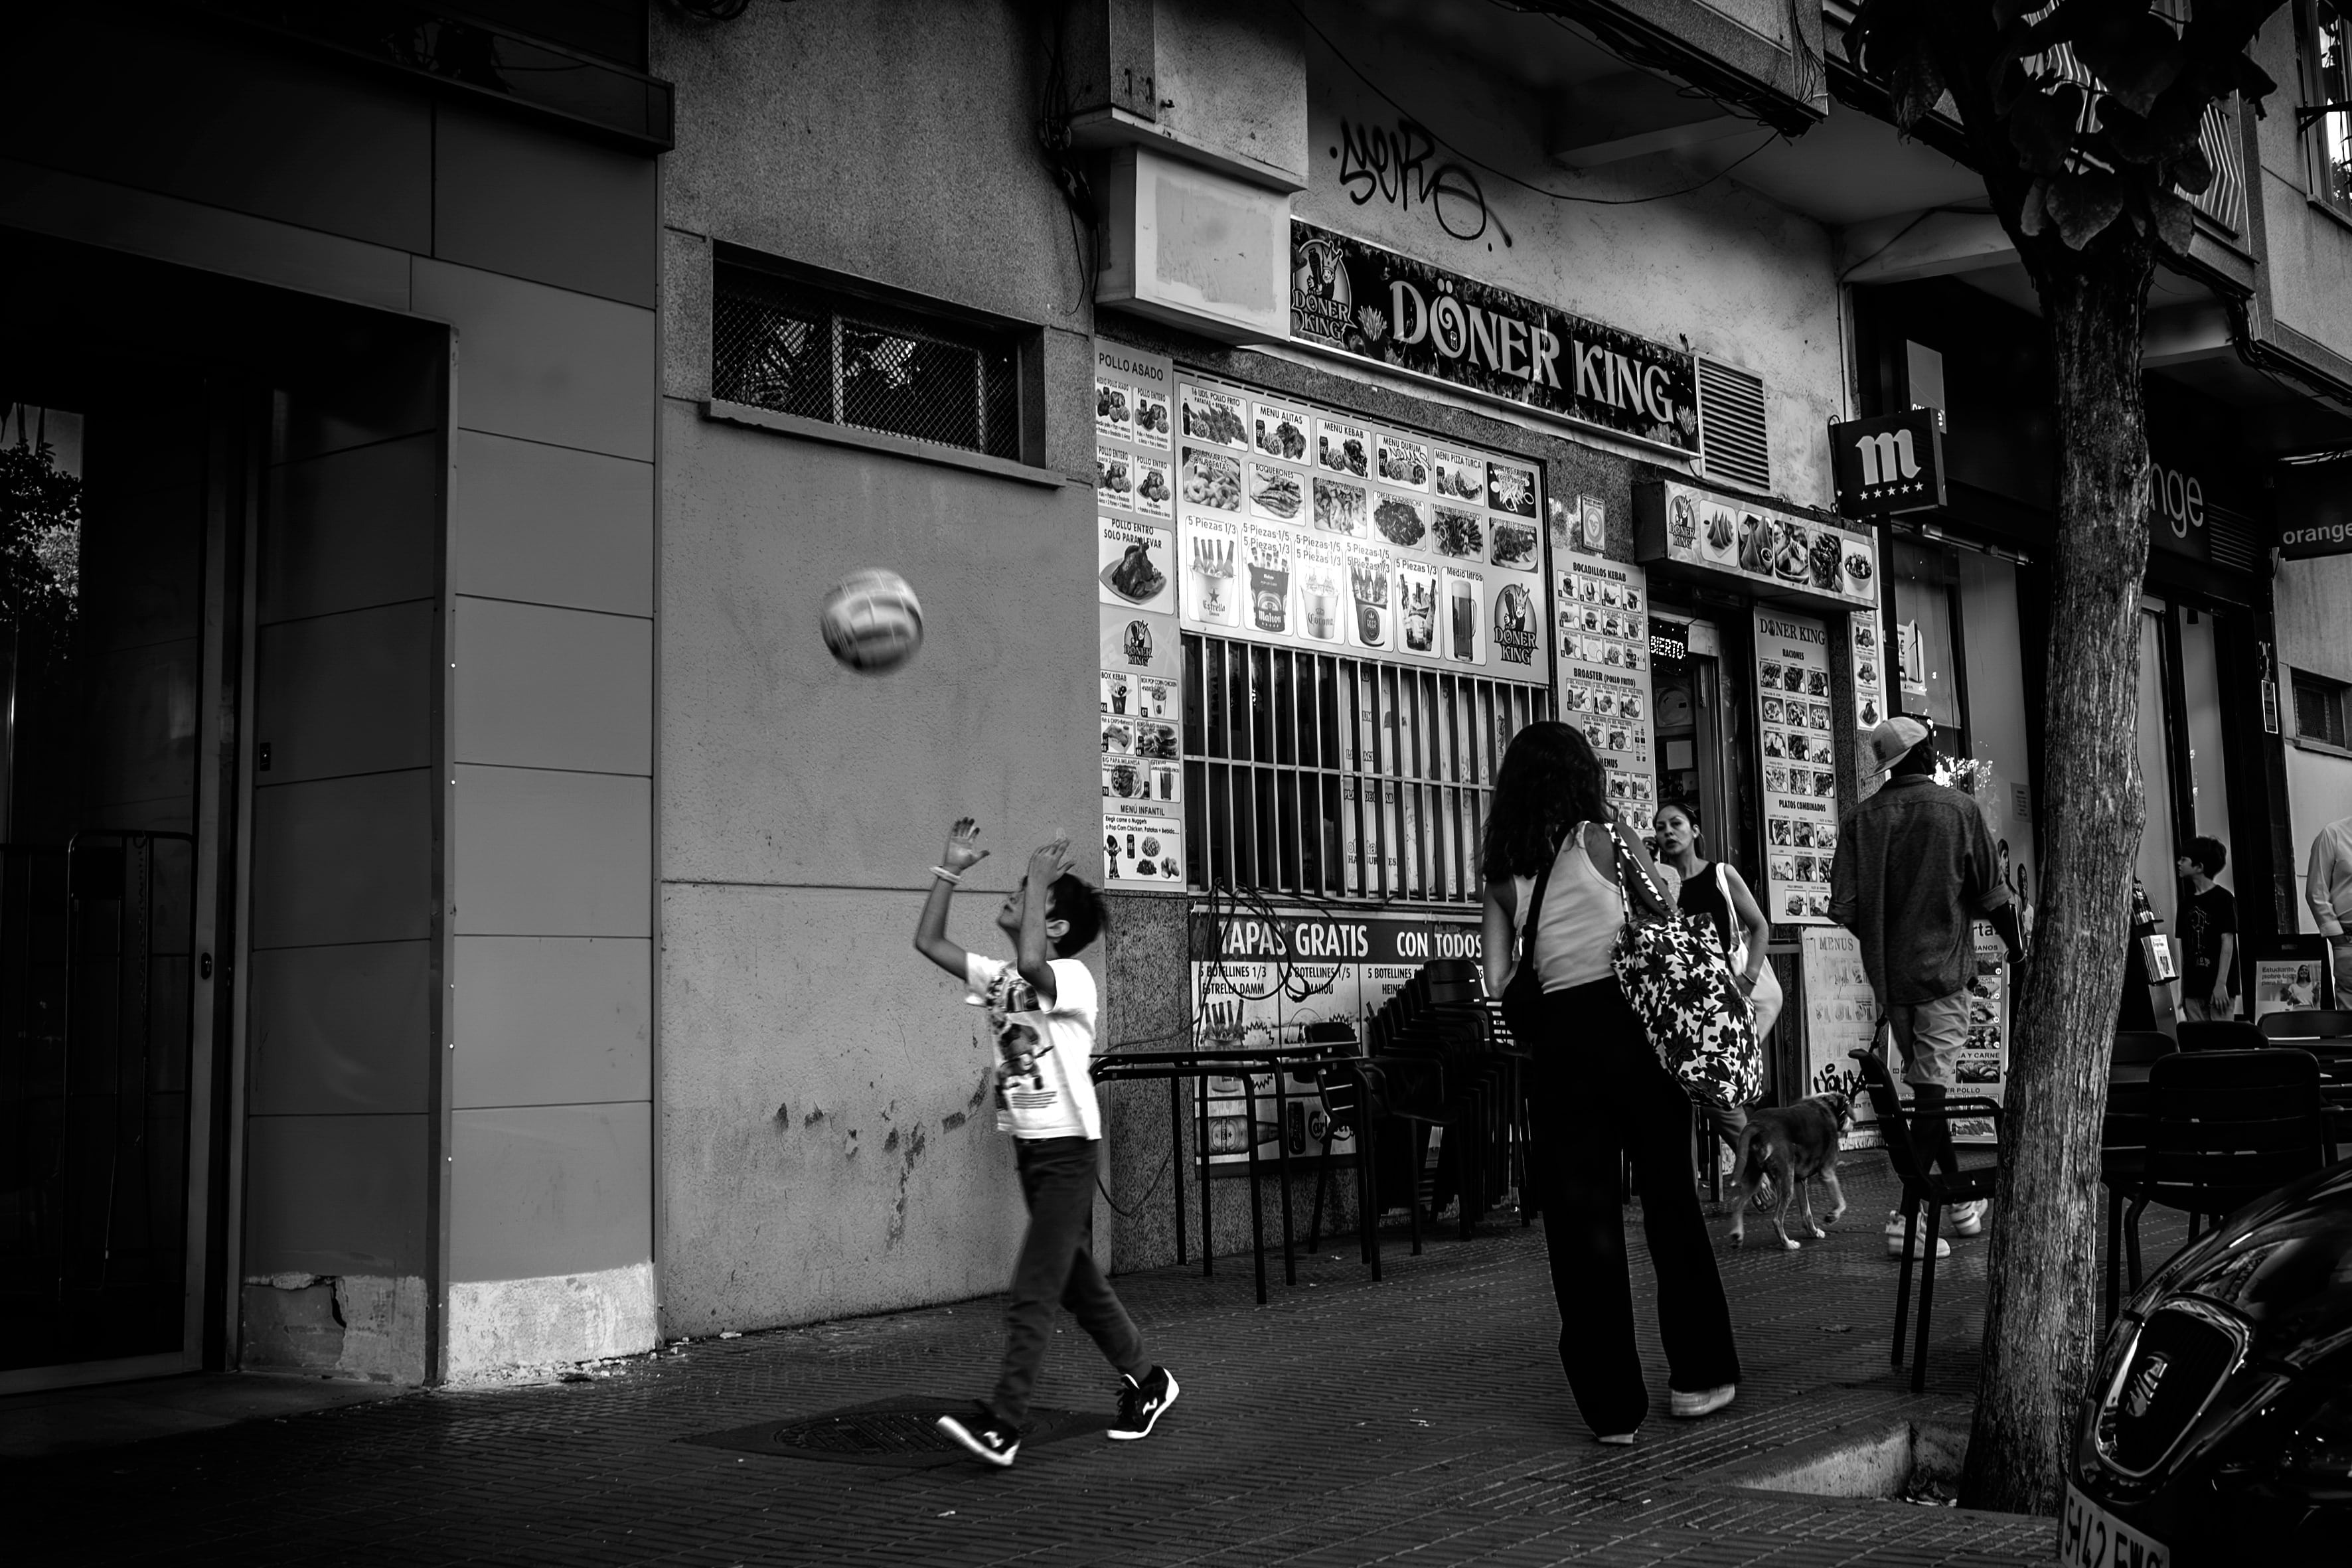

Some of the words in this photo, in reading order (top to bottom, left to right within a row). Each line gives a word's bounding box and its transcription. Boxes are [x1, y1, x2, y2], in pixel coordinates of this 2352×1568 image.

[1304, 313, 1342, 339] KING
[1099, 353, 1129, 372] POLLO
[1132, 362, 1163, 381] ASADO
[1107, 378, 1117, 388] POLLO
[1574, 339, 1676, 426] KING
[1137, 388, 1150, 398] POLLO
[1151, 390, 1166, 402] ENTERO
[1210, 392, 1226, 403] POLLO
[1227, 398, 1240, 406] FRITO
[1260, 406, 1279, 419] MENU
[1281, 412, 1302, 424] ALITAS
[1324, 422, 1342, 433] MENU
[1344, 426, 1364, 439] KEBAB
[1099, 445, 1111, 457] POLLO
[1113, 449, 1128, 461] ENTERO
[1383, 437, 1399, 447] MENU
[1401, 441, 1421, 453] DURUM
[1137, 455, 1151, 465] POLLO
[1152, 459, 1167, 469] ENTRO
[1435, 450, 1450, 461] MENU
[1450, 454, 1464, 465] PIZZA
[1465, 458, 1482, 469] TURCA
[1255, 463, 1294, 479] BOQUERONES
[2150, 463, 2203, 538] nge
[1112, 518, 1131, 531] POLLO
[1134, 523, 1154, 535] ENTRO
[1188, 516, 1193, 525] 5
[1196, 516, 1223, 532] Piezas
[1225, 523, 1236, 535] 1/3
[1243, 523, 1248, 532] 5
[1250, 524, 1277, 538] Piezas
[1279, 530, 1290, 542] 1/5
[1105, 529, 1121, 540] SOLO
[1123, 532, 1138, 544] PARA
[1296, 534, 1301, 544] 5
[1303, 536, 1328, 549] Piezas
[1330, 541, 1341, 552] 1/5
[1244, 536, 1248, 546] 5
[1251, 538, 1277, 552] Piezas
[1279, 543, 1290, 554] 1/3
[1347, 542, 1352, 552] 5
[1354, 544, 1377, 557] Piezas
[1379, 549, 1389, 560] 1/5
[1297, 549, 1301, 558] 5
[1303, 550, 1328, 564] Piezas
[1330, 555, 1341, 566] 1/3
[1348, 557, 1352, 566] 5
[1354, 558, 1377, 571] Piezas
[1402, 560, 1425, 573] Piezas
[1427, 564, 1437, 576] 1/3
[1447, 567, 1465, 578] Medio
[1467, 570, 1483, 582] litros
[1573, 562, 1607, 578] BOCADILLOS
[1608, 570, 1626, 582] KEBAB
[1798, 626, 1826, 645] KING
[1129, 656, 1148, 666] KING
[1502, 644, 1531, 666] KING
[1782, 649, 1804, 661] RACIONES
[1573, 668, 1603, 681] BROASTER
[1604, 674, 1620, 684] (POLLO
[1621, 677, 1636, 688] FRITO)
[1599, 757, 1618, 768] MENUS
[1121, 803, 1137, 814] MENÚ
[1139, 807, 1165, 816] INFANTIL
[1779, 799, 1796, 809] PLATOS
[1797, 801, 1826, 812] COMBINADOS
[1219, 921, 1288, 955] TAPAS
[1295, 923, 1368, 957] GRATIS
[1397, 931, 1428, 957] CON
[1435, 933, 1482, 958] TODOS
[1819, 937, 1853, 951] MENUS
[1207, 966, 1250, 978] BOTELLINES
[1253, 966, 1267, 980] 1/3
[1294, 967, 1334, 979] BOTELLINES
[1338, 967, 1350, 981] 1/5
[1368, 968, 1372, 979] 5
[1375, 968, 1411, 979] BOTELLINES
[1203, 983, 1237, 995] ESTRELLA
[1240, 983, 1265, 994] DAMM
